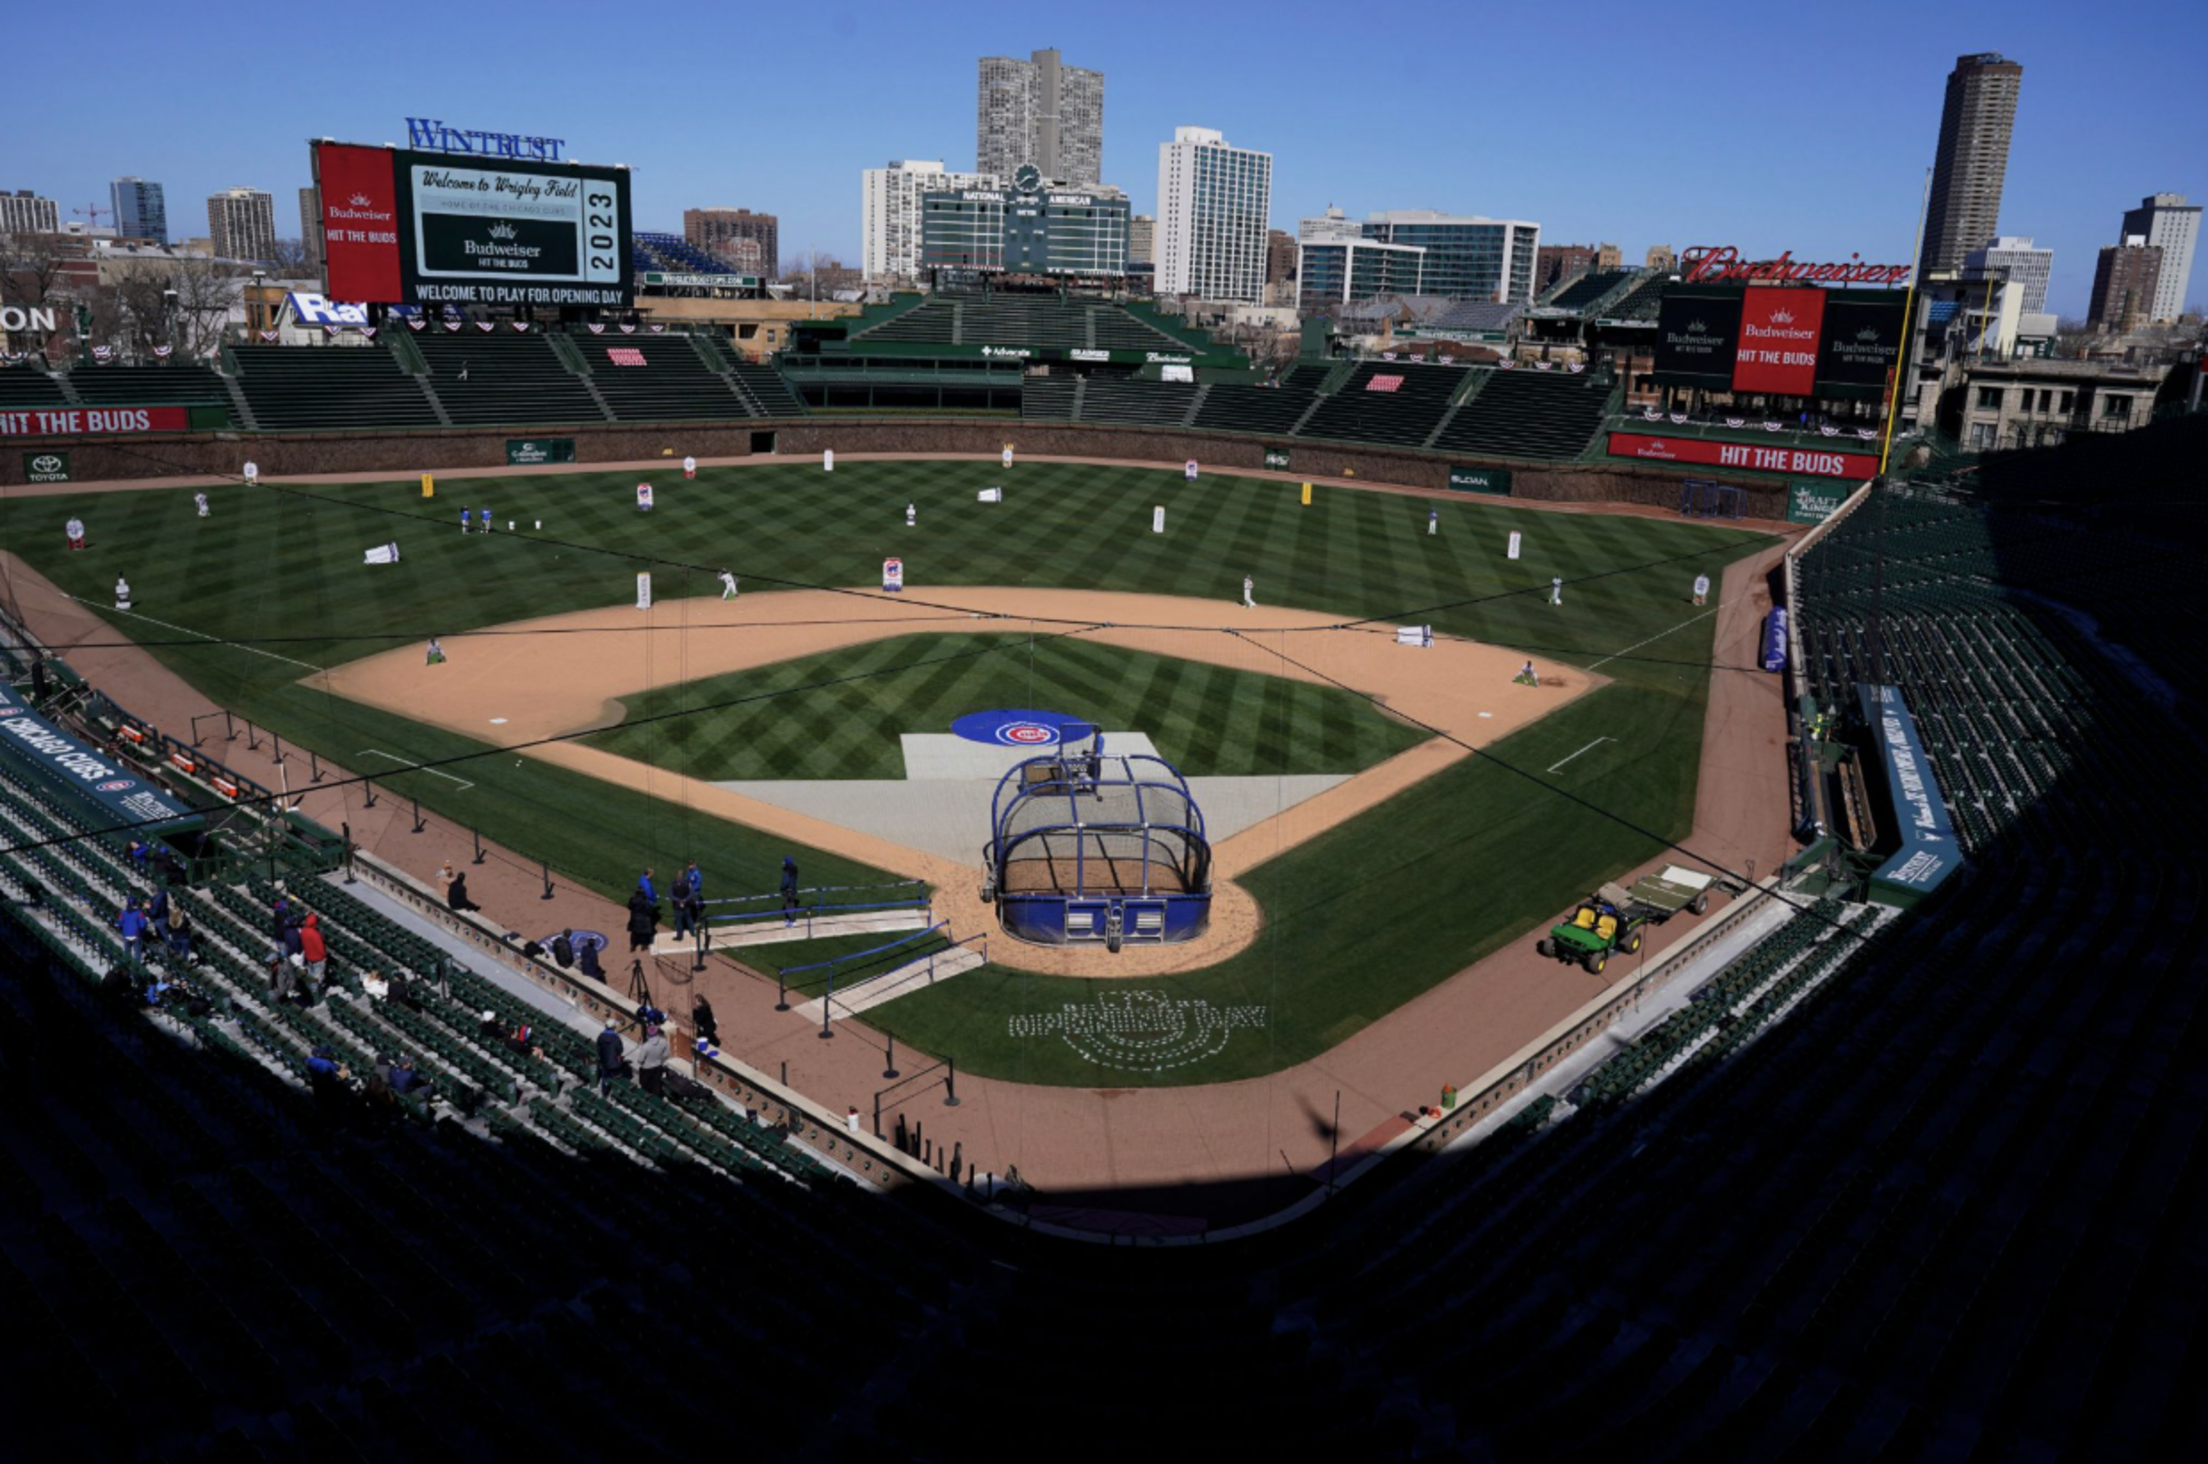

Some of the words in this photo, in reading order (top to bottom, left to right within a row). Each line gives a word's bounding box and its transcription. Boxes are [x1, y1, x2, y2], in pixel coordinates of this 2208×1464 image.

[423, 170, 475, 191] Welcome
[478, 178, 490, 192] to
[495, 175, 541, 201] Wrigley
[545, 179, 578, 199] Field
[963, 191, 1005, 201] NATIONAL
[1049, 196, 1091, 205] AMERICAN
[329, 206, 392, 221] Budweiser
[327, 229, 344, 242] HIT
[347, 230, 367, 243] THE
[368, 231, 397, 244] BUDS
[589, 192, 614, 270] 2023
[464, 239, 541, 257] Budweiser
[478, 257, 491, 268] HIT
[1682, 246, 1912, 284] Budweiser
[416, 284, 477, 301] WELCOME
[479, 286, 495, 301] TO
[497, 287, 526, 301] PLAY
[528, 287, 551, 302] FOR
[552, 288, 600, 303] OPENING
[602, 290, 623, 304] DAY
[1667, 332, 1725, 347] Budweiser
[1745, 323, 1815, 339] Budweiser
[1737, 348, 1757, 362] HIT
[1759, 350, 1781, 364] THE
[1782, 352, 1815, 366] BUDS
[1833, 341, 1899, 355] Budweiser
[0, 412, 30, 434] HIT
[35, 411, 82, 434] THE
[87, 409, 150, 432] BUDS
[1720, 445, 1751, 466] HIT
[1754, 448, 1788, 469] THE
[1792, 451, 1845, 475] BUDS
[29, 473, 69, 482] TOYOTA
[1, 717, 75, 755] CHICAGO
[55, 752, 115, 782] CUBS
